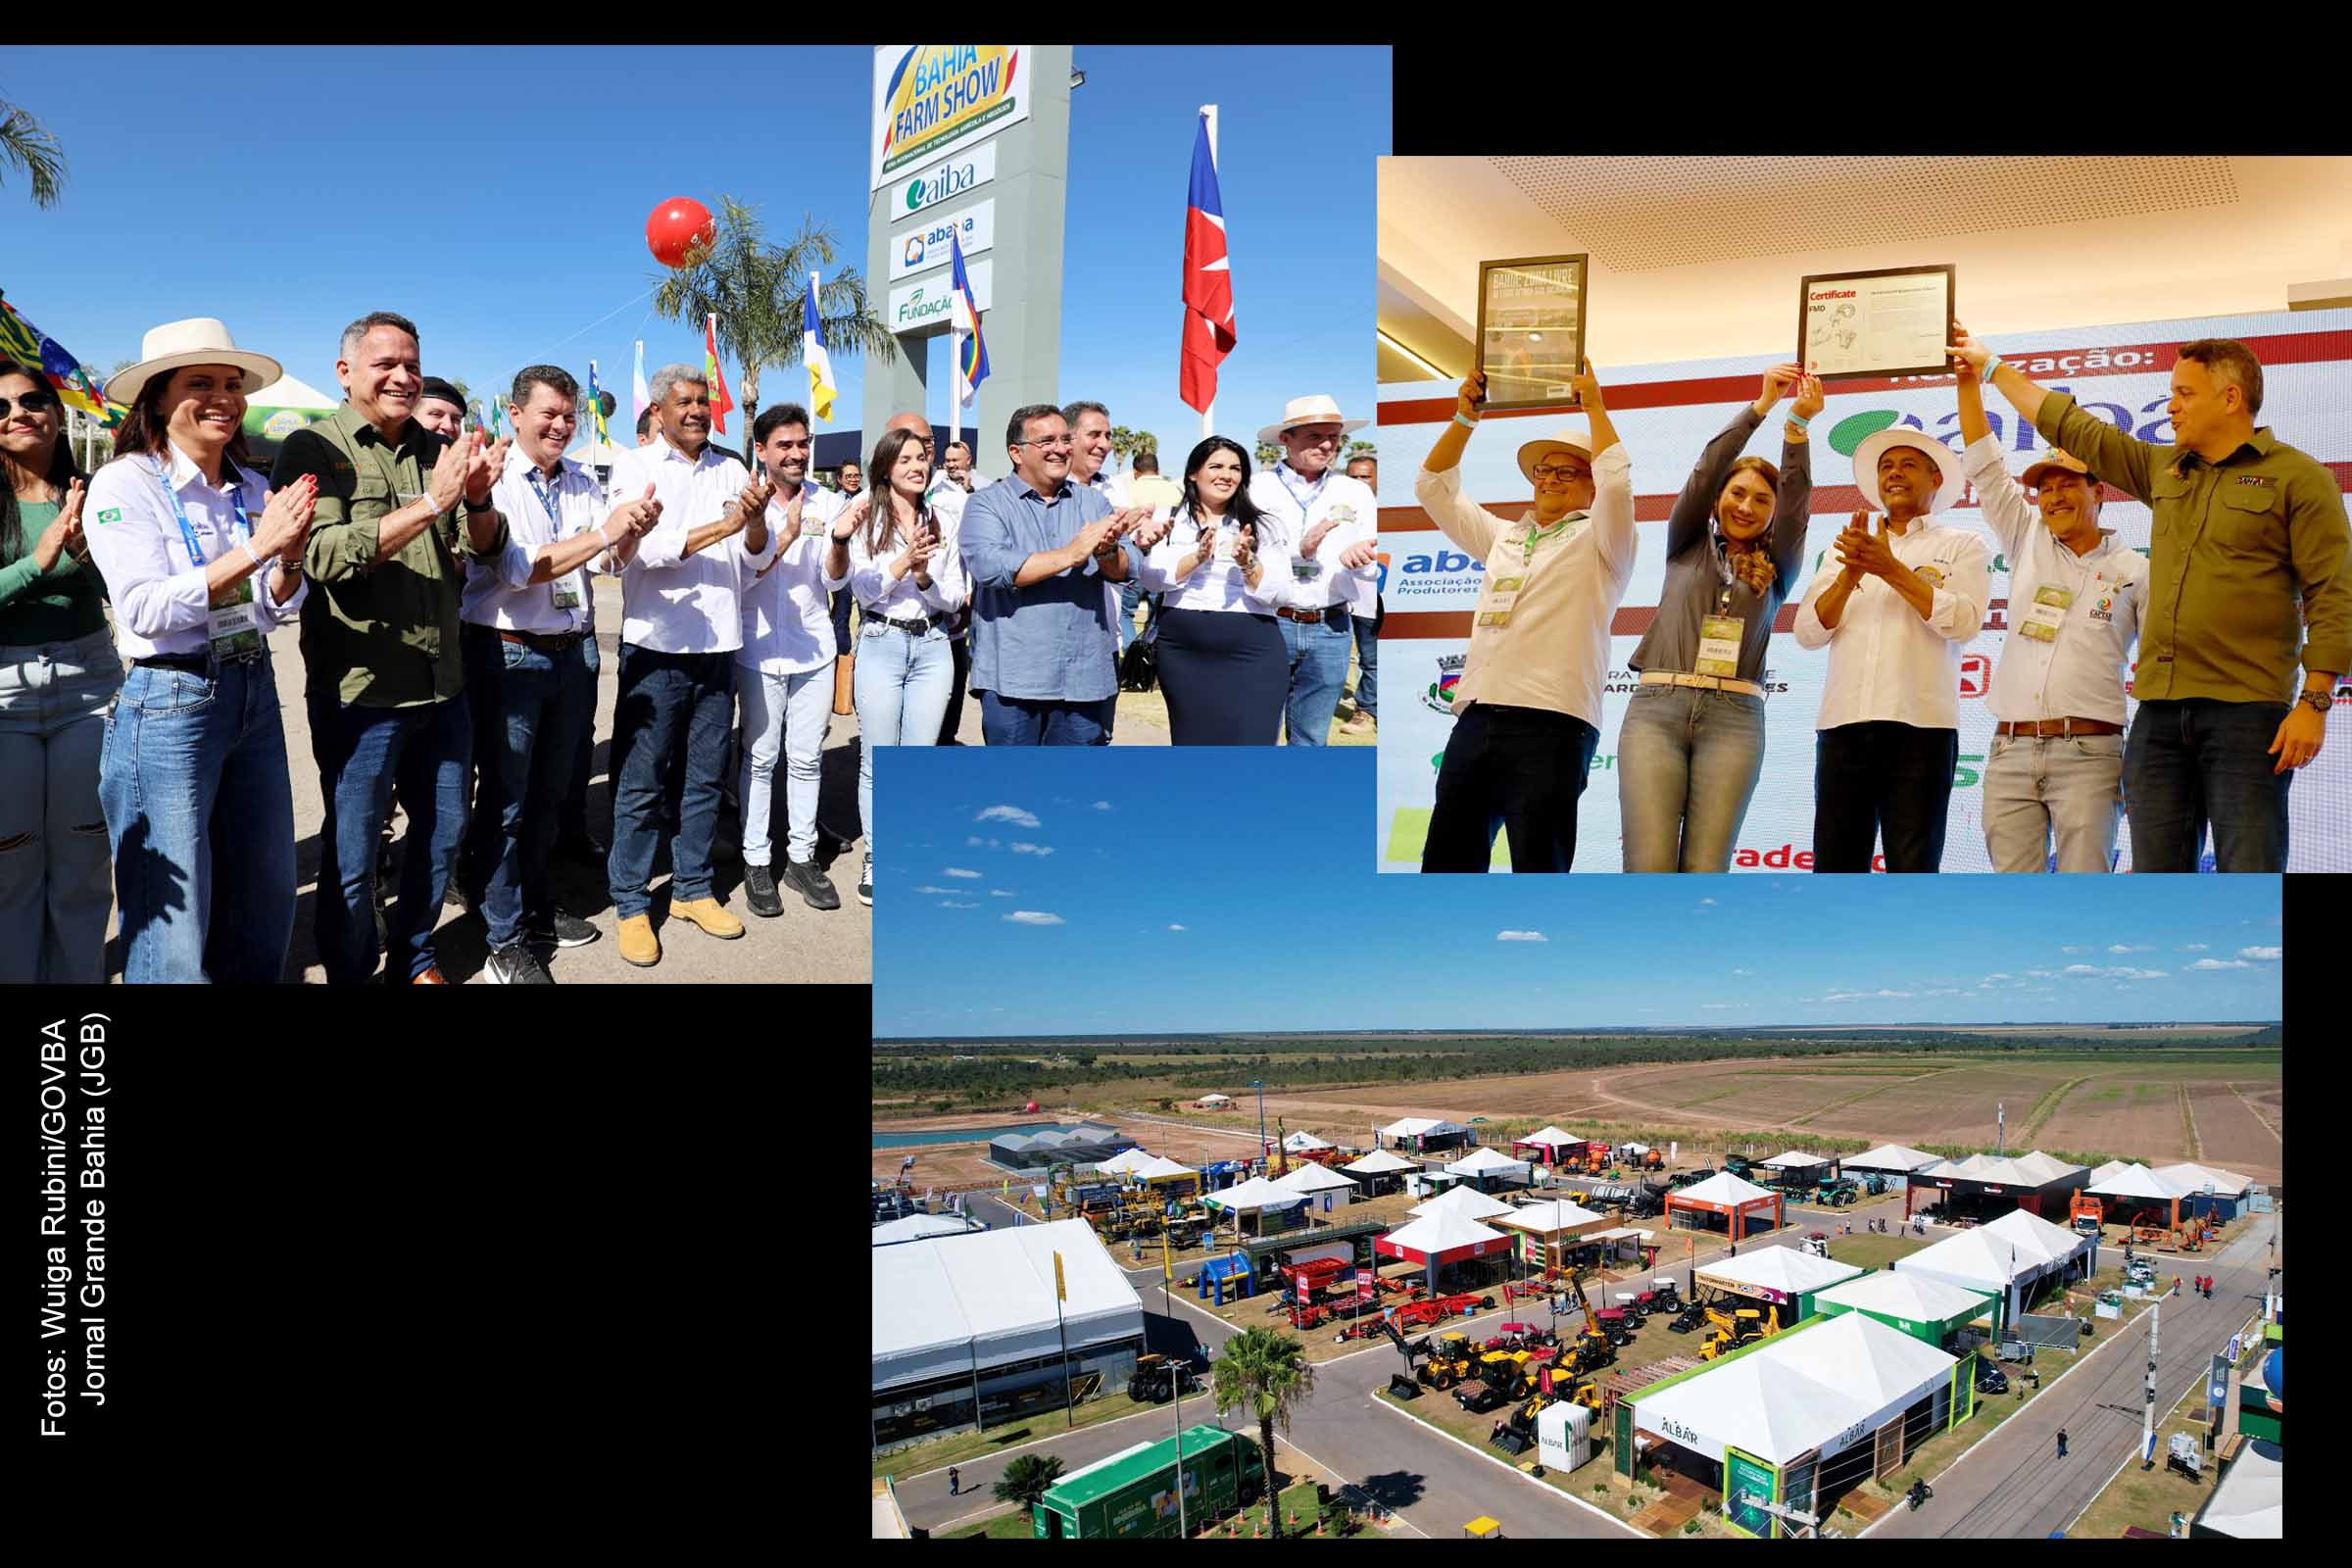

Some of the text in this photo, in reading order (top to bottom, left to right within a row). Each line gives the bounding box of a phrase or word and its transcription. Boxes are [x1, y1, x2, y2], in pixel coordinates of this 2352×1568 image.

[913, 45, 977, 97] BAHIA
[896, 57, 1001, 143] FARM SHOW
[926, 163, 974, 204] aiba
[927, 218, 973, 246] abaa
[1809, 289, 1857, 301] Certificate
[1397, 586, 1479, 596] Produtores
[1398, 577, 1483, 588] Associação
